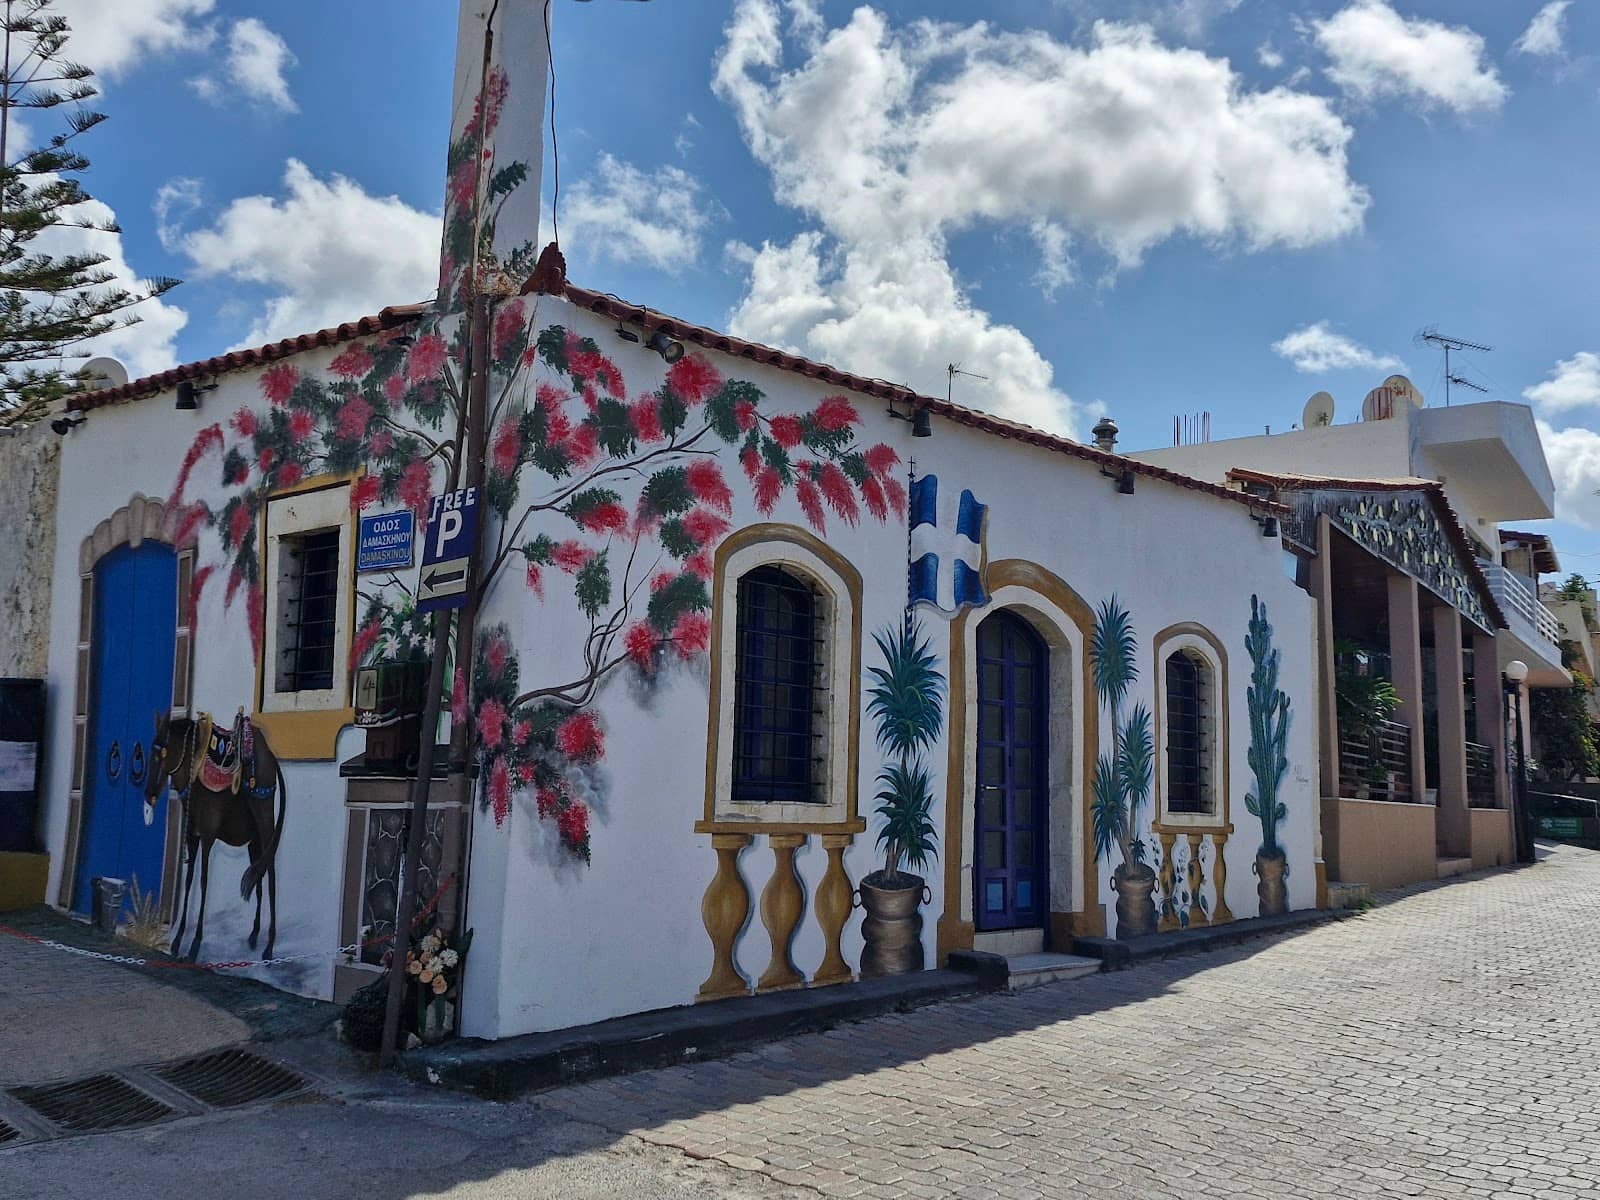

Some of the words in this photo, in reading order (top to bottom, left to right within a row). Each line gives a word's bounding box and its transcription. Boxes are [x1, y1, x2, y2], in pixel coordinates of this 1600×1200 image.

[428, 487, 476, 523] FREE
[373, 519, 400, 533] ΟΔΟΣ
[362, 533, 410, 548] ΔΑΜΑΣΚΗΝΟΥ
[435, 510, 463, 558] P
[361, 548, 410, 563] DAMASKINOU
